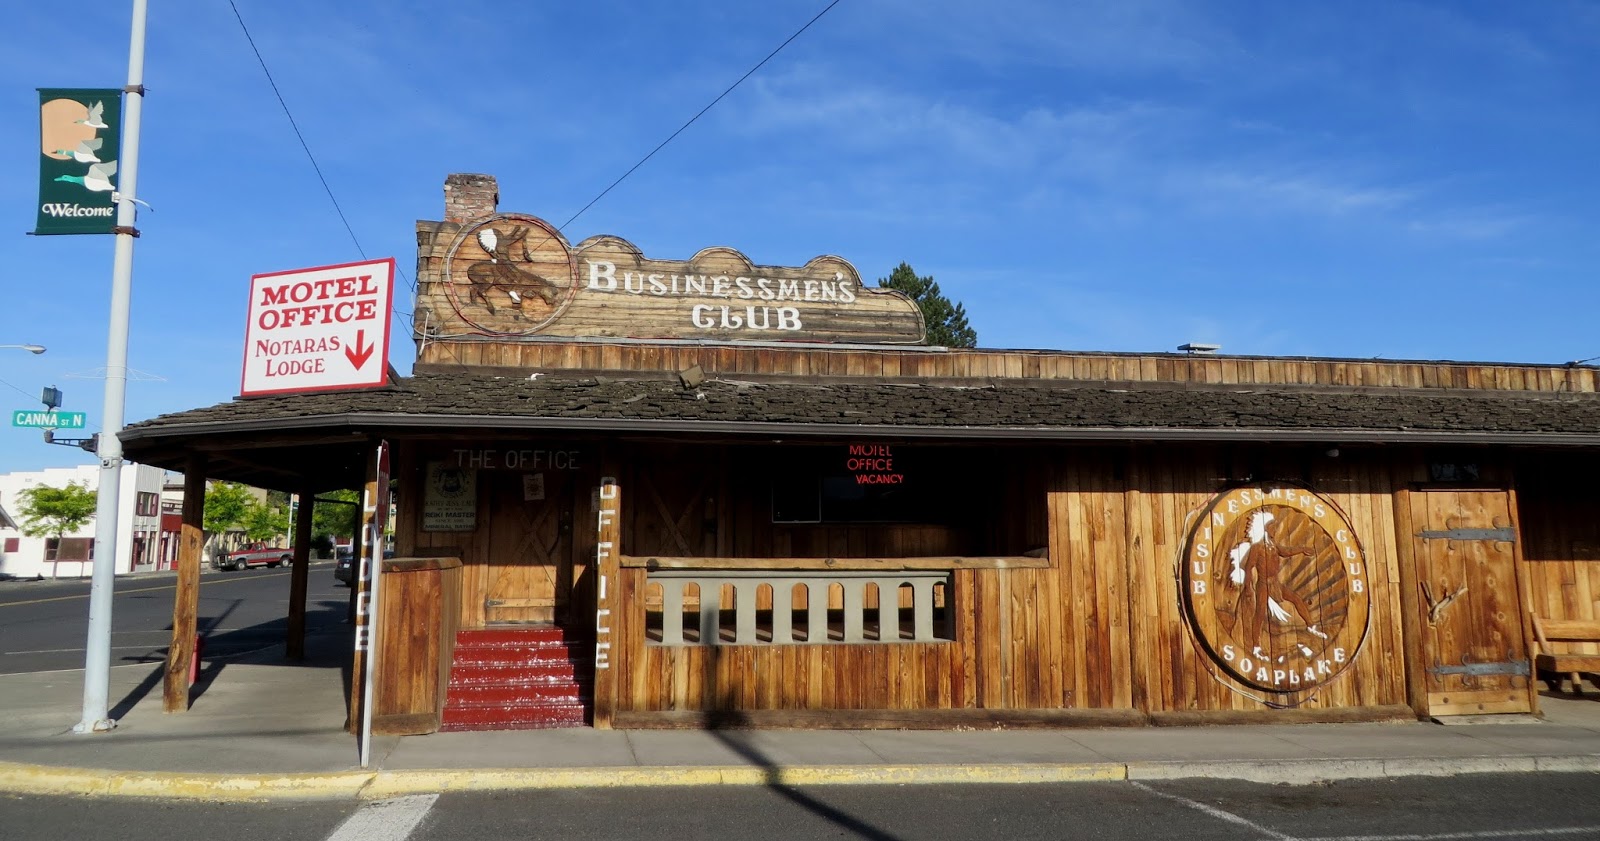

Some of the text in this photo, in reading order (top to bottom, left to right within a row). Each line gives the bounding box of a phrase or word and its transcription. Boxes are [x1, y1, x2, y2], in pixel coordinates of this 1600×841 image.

[42, 203, 114, 217] Welcome
[261, 275, 378, 306] MOTEL
[585, 259, 856, 304] BUSINESSMEN'S
[258, 299, 377, 330] OFFICE
[691, 303, 803, 331] CLUB
[255, 336, 340, 357] NOTARAS
[265, 358, 325, 377] LODGE
[17, 413, 58, 426] CANNA
[73, 414, 82, 427] N
[453, 449, 581, 470] THE OFFICE
[849, 445, 893, 457] MOTEL
[847, 458, 893, 471] OFFICE
[855, 474, 904, 484] VACANCY
[595, 476, 616, 668] OFFICE
[1335, 529, 1364, 594] CLUB
